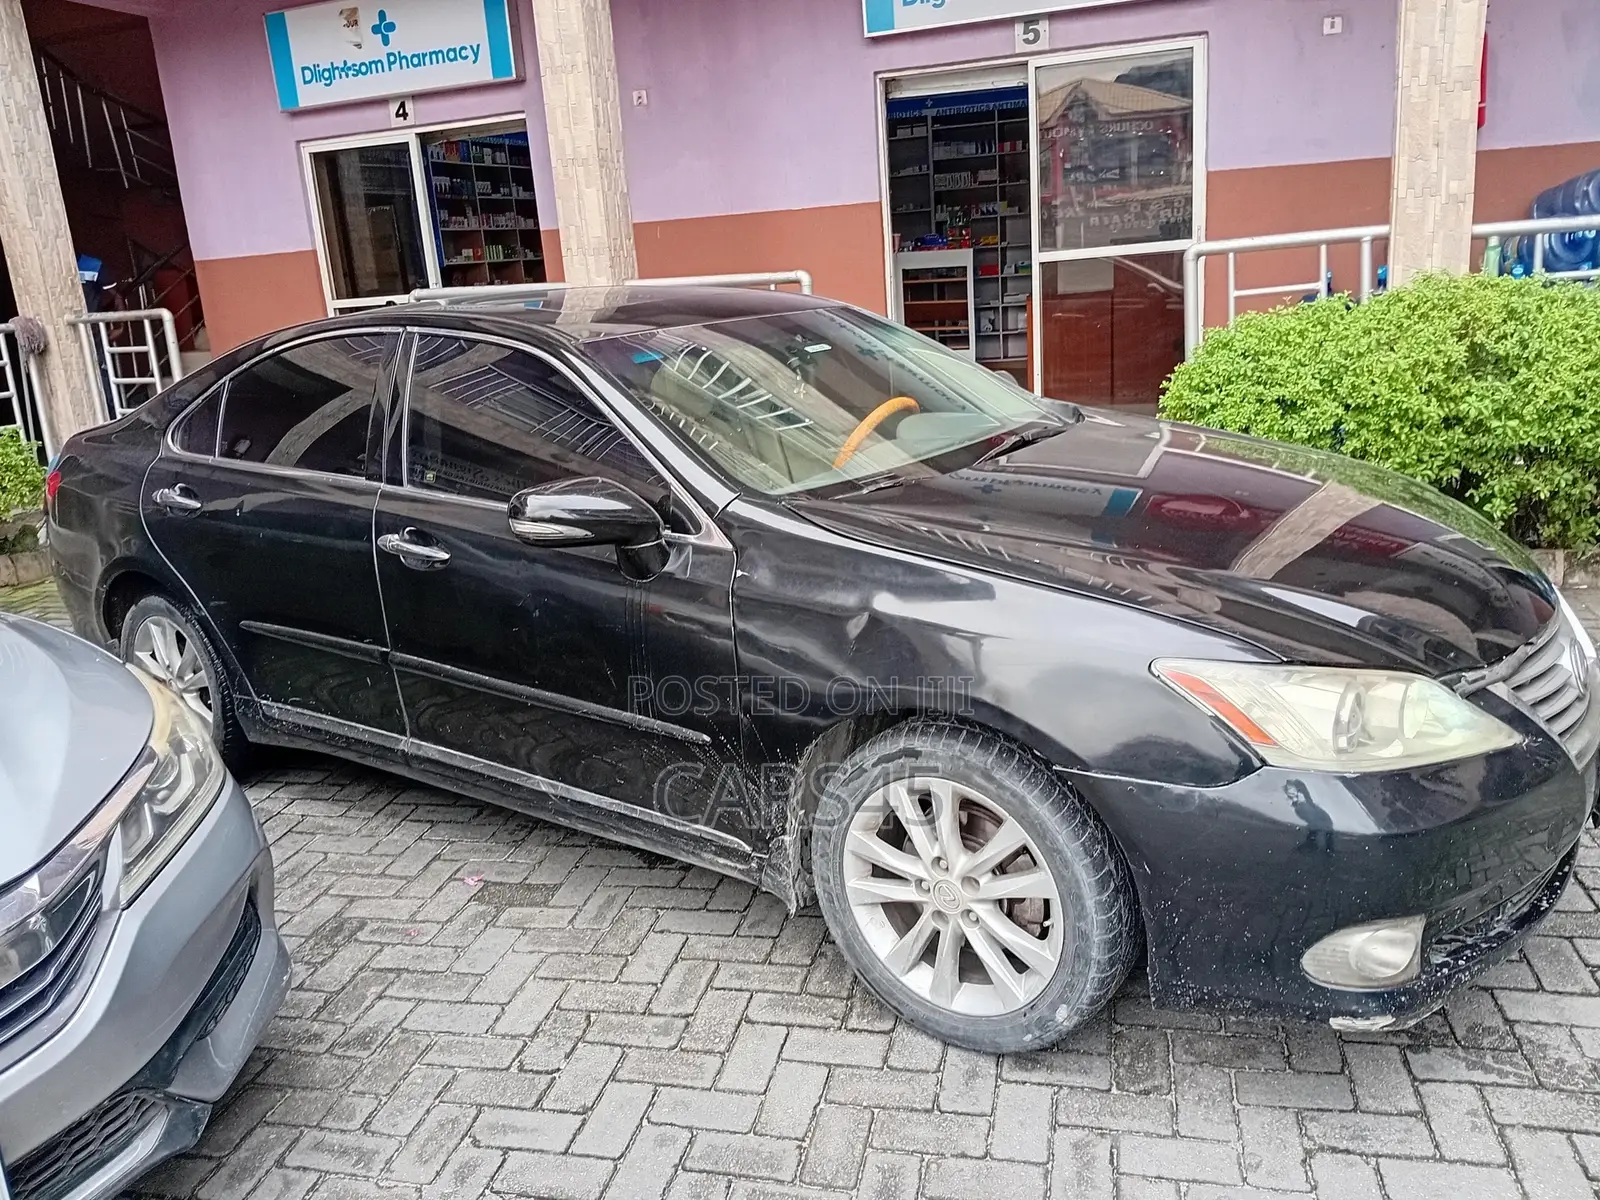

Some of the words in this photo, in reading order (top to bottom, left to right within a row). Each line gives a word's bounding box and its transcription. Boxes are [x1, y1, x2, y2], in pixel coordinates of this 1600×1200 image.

[1021, 19, 1041, 45] 5
[386, 43, 482, 71] Pharmacy
[394, 100, 409, 121] 4
